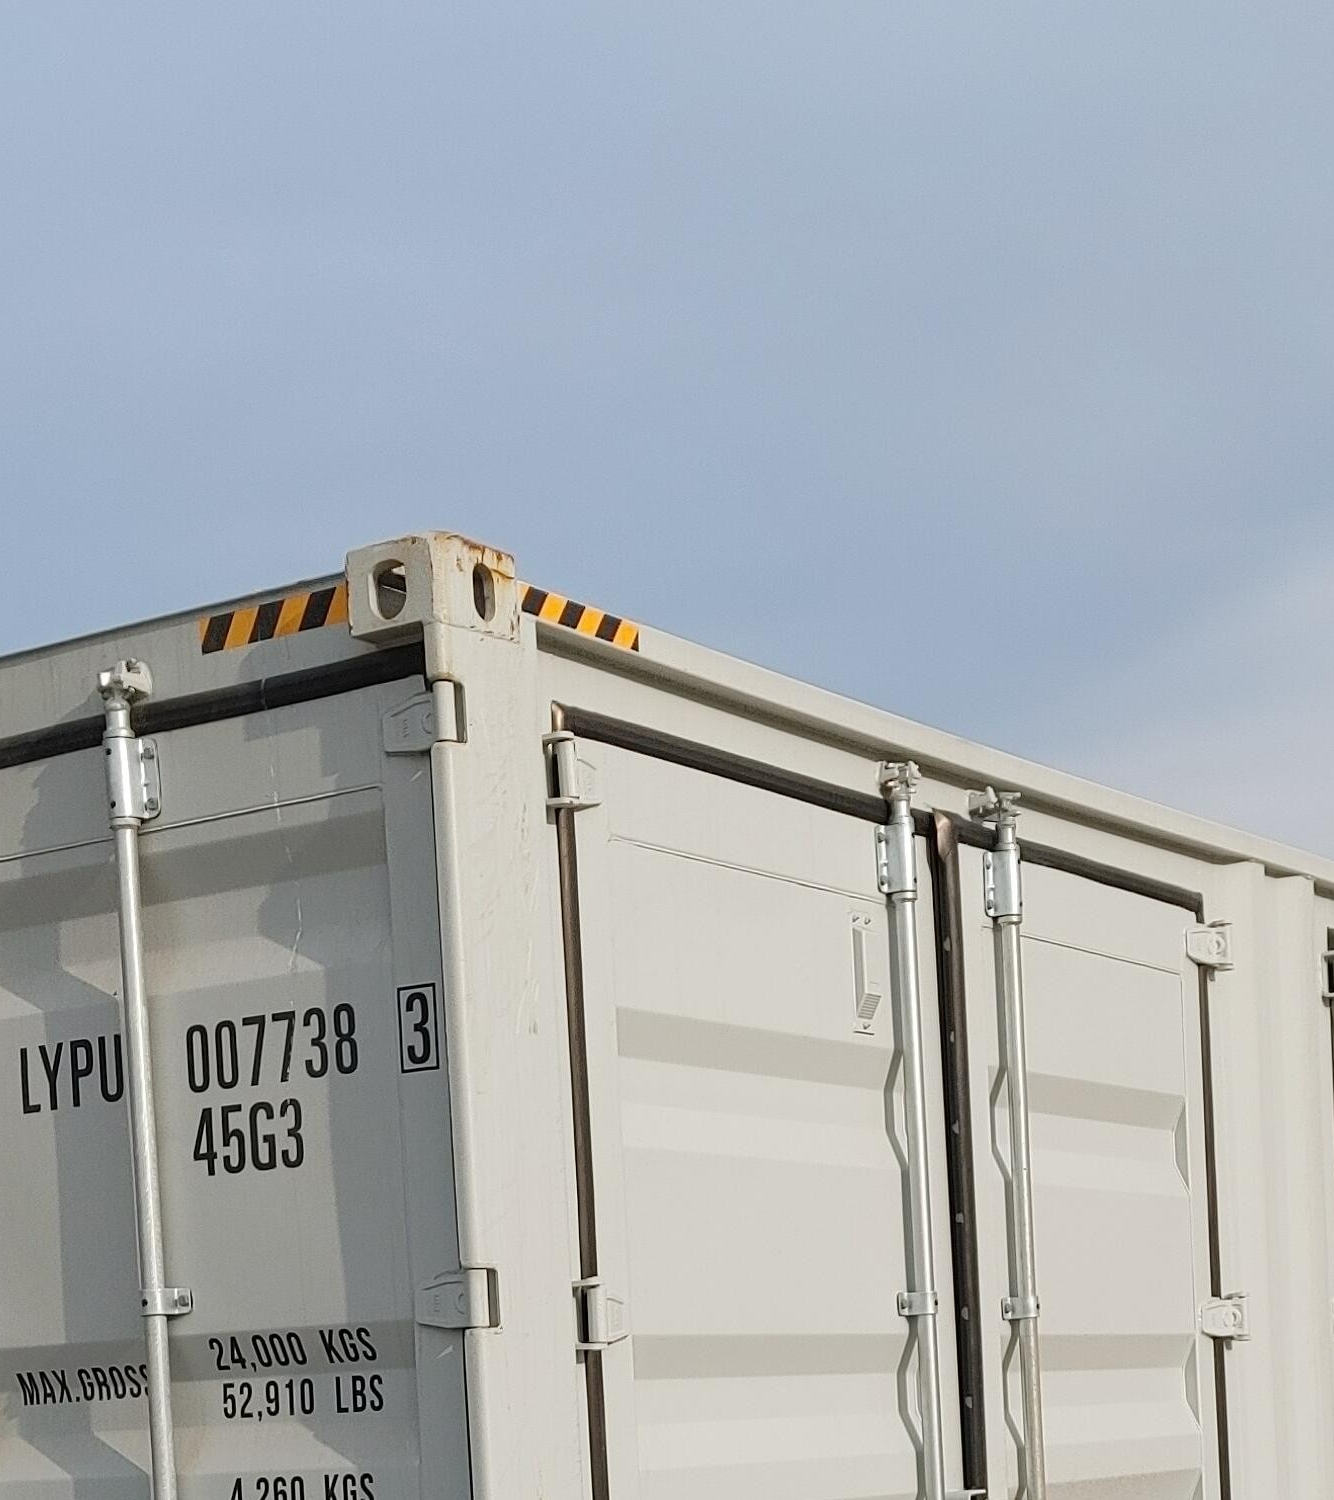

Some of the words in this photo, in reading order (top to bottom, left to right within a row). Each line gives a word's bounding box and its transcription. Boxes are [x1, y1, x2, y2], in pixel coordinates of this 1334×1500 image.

[20, 1033, 125, 1115] LYPU
[186, 1002, 359, 1094] 007738
[406, 991, 431, 1066] 3
[192, 1098, 305, 1177] 45G3
[208, 1331, 308, 1373] 24,000
[318, 1327, 378, 1364] KGS
[222, 1378, 315, 1422] 52,910
[335, 1374, 384, 1414] LBS
